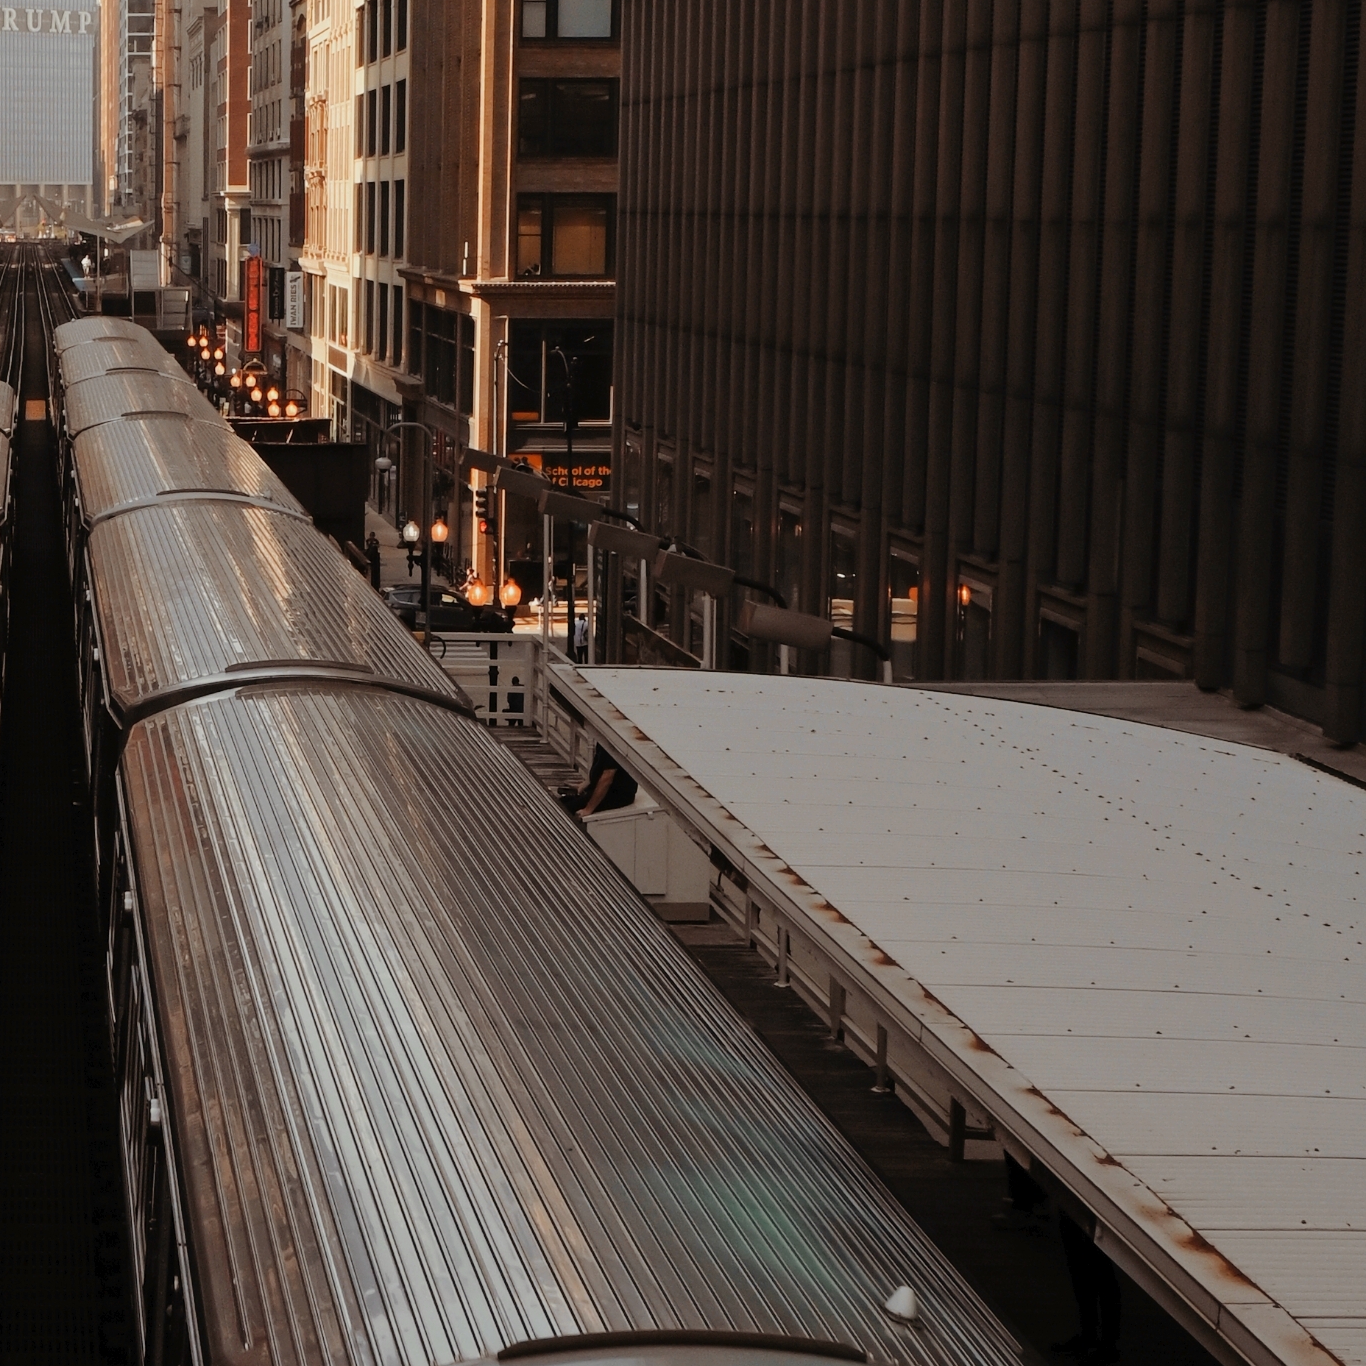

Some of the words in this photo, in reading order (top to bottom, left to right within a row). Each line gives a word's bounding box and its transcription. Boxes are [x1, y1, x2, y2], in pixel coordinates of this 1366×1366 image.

[545, 466, 582, 476] School
[583, 466, 596, 476] of
[558, 477, 602, 488] Cicago
